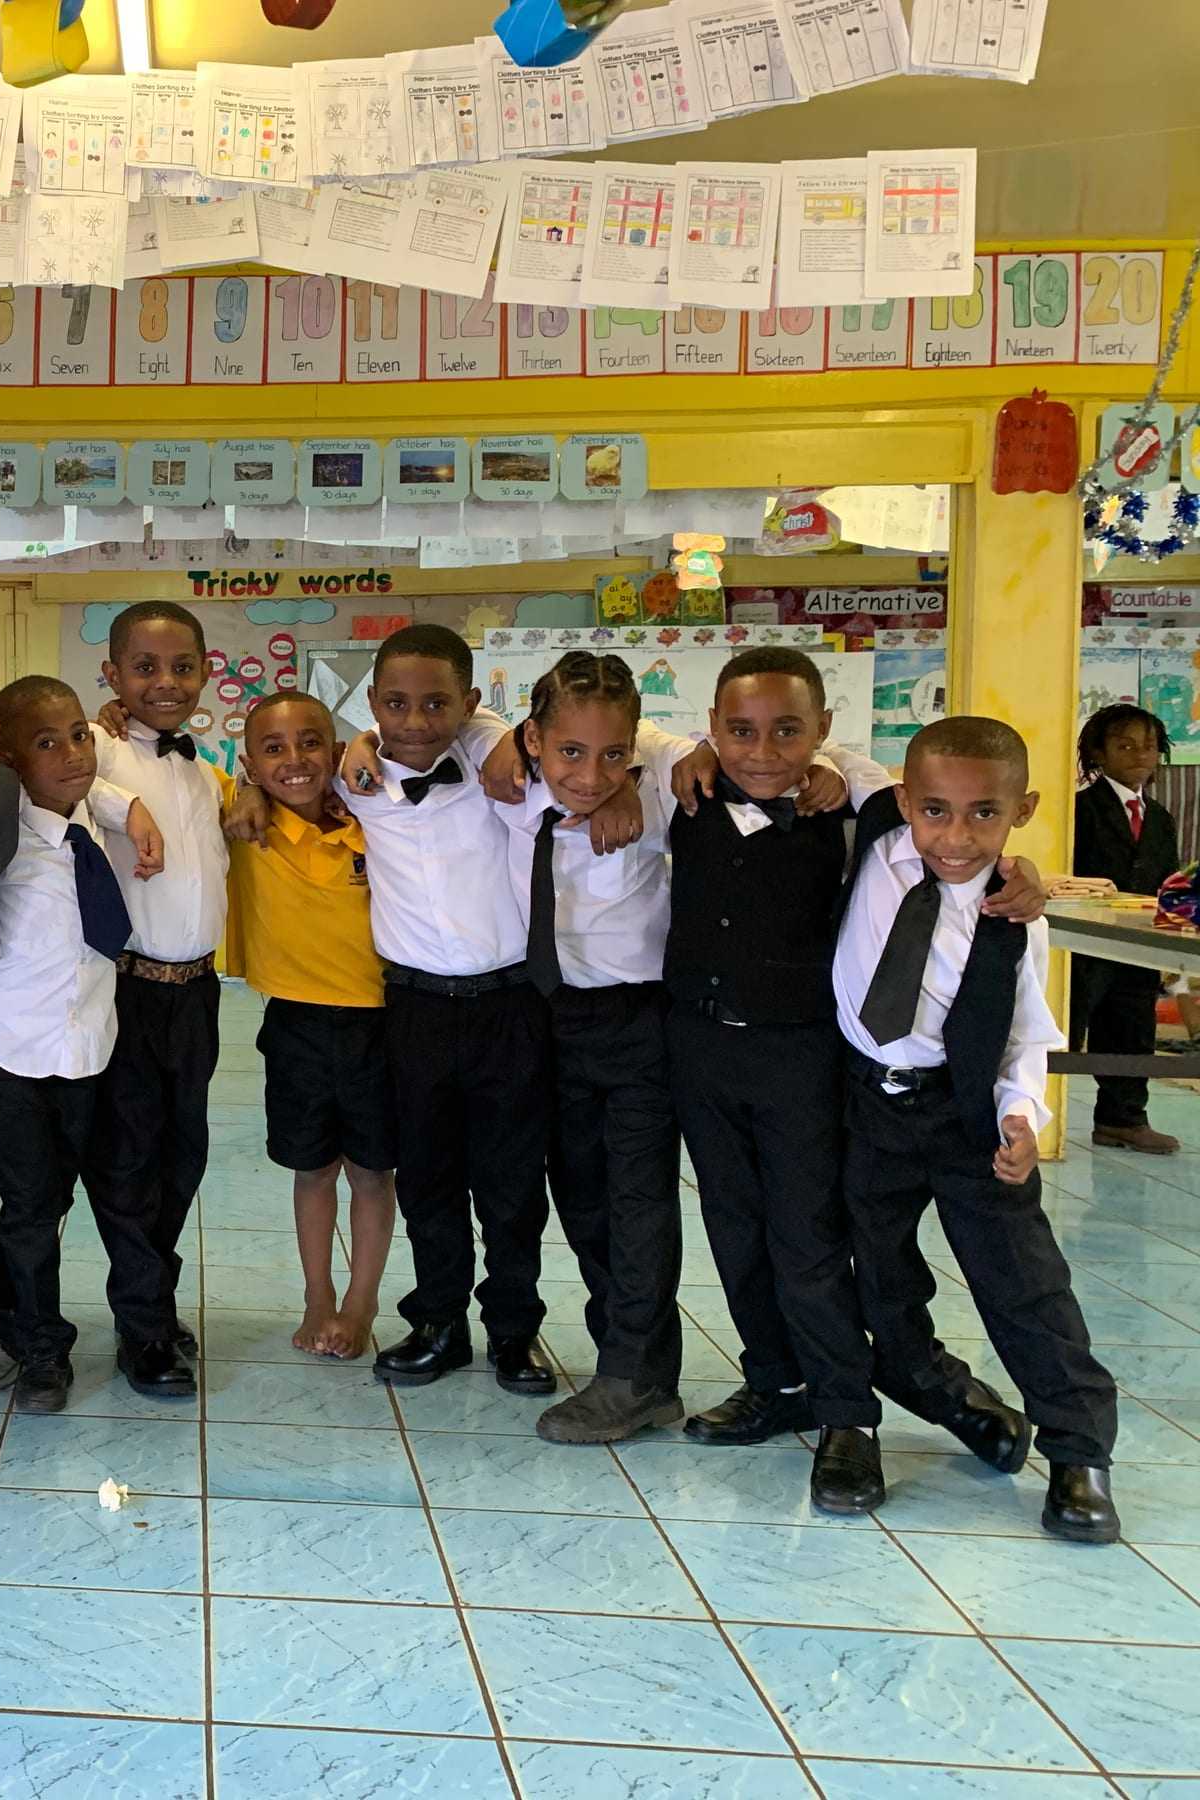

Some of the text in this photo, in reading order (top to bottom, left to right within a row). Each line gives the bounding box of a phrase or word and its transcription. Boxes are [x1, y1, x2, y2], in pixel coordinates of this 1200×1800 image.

[1004, 260, 1068, 328] 19
[1084, 257, 1158, 325] 20
[62, 284, 91, 345] 7
[139, 278, 169, 342] 8
[214, 277, 248, 343] 9
[275, 276, 335, 341] 10
[346, 280, 399, 341] 11
[675, 343, 723, 364] Fifteen
[754, 347, 804, 366] Sixteen
[836, 343, 896, 362] Seventeen
[925, 342, 971, 368] Eighteen
[1006, 338, 1054, 357] Nineteen
[1086, 335, 1137, 359] Twenty
[50, 355, 89, 375] Seven
[139, 352, 170, 380] Eight
[214, 355, 244, 375] Nine
[291, 353, 313, 371] Ten
[357, 352, 400, 374] Eleven
[438, 352, 477, 373] Twelve
[519, 350, 561, 369] Thirteen
[599, 348, 649, 368] Fourteen
[66, 441, 106, 454] June has
[224, 440, 276, 456] August has
[305, 438, 371, 453] September has
[396, 438, 456, 449] October has
[480, 437, 544, 449] November has
[570, 433, 640, 446] December has
[0, 446, 16, 456] has
[153, 442, 192, 458] July has
[188, 568, 393, 596] Tricky words
[808, 593, 941, 612] Alternative
[1112, 590, 1192, 608] countable
